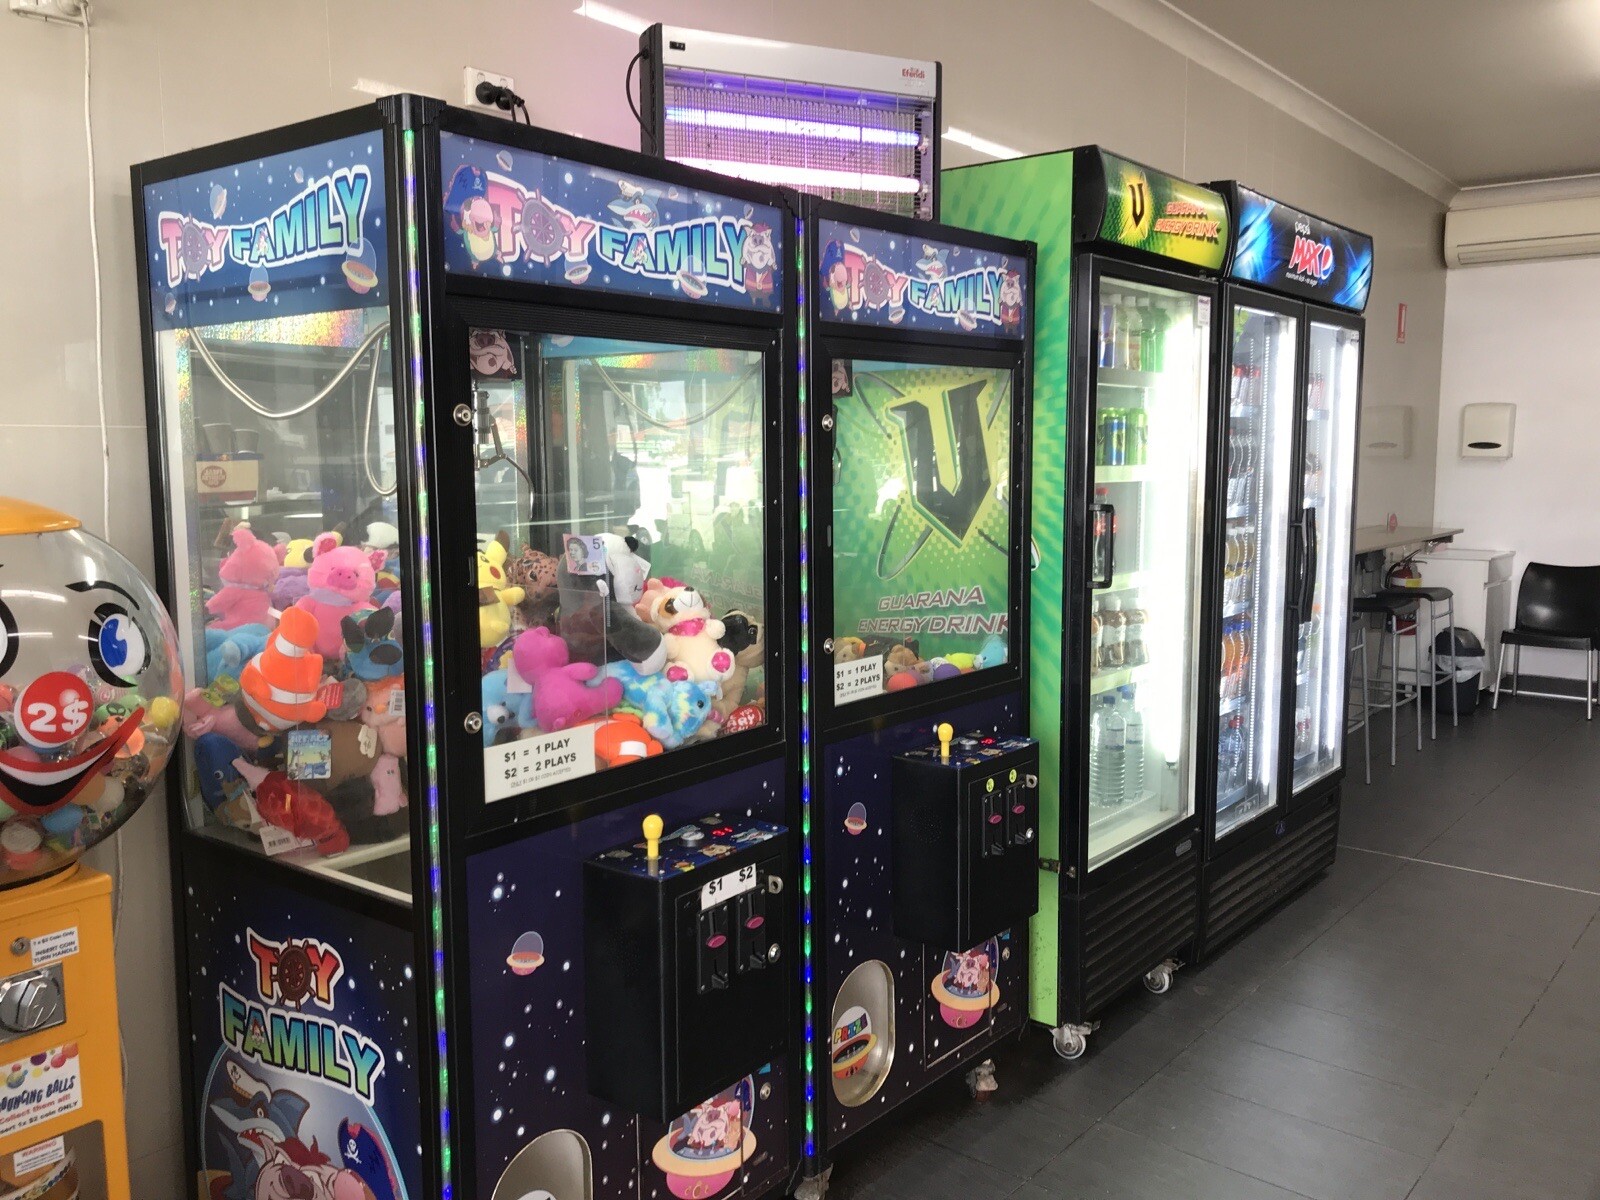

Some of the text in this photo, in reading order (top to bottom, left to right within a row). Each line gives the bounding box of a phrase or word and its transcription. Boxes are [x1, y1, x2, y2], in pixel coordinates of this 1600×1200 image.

[159, 165, 371, 287] TOY FAMILY
[486, 171, 748, 293] TOY FAMILY
[1288, 235, 1325, 278] MAX
[843, 243, 1005, 325] TOY FAMILY
[592, 538, 600, 549] 5
[878, 585, 985, 612] GUARANA
[858, 613, 1008, 635] ENERGY DRINK
[836, 670, 844, 679] $1
[855, 666, 859, 674] 1
[860, 663, 877, 673] PLAY
[836, 683, 844, 691] $2
[860, 674, 881, 685] PLAYS
[504, 751, 516, 763] $1
[535, 745, 541, 754] 1
[545, 738, 570, 752] PLAY
[504, 768, 517, 780] $2
[535, 761, 542, 772] 2
[545, 753, 576, 769] PLAYS
[708, 878, 723, 895] $1
[739, 866, 753, 883] $2
[247, 927, 344, 1012] TOY
[219, 981, 385, 1106] FAMILY
[46, 1075, 76, 1097] BALLS
[57, 1100, 78, 1113] ONLY
